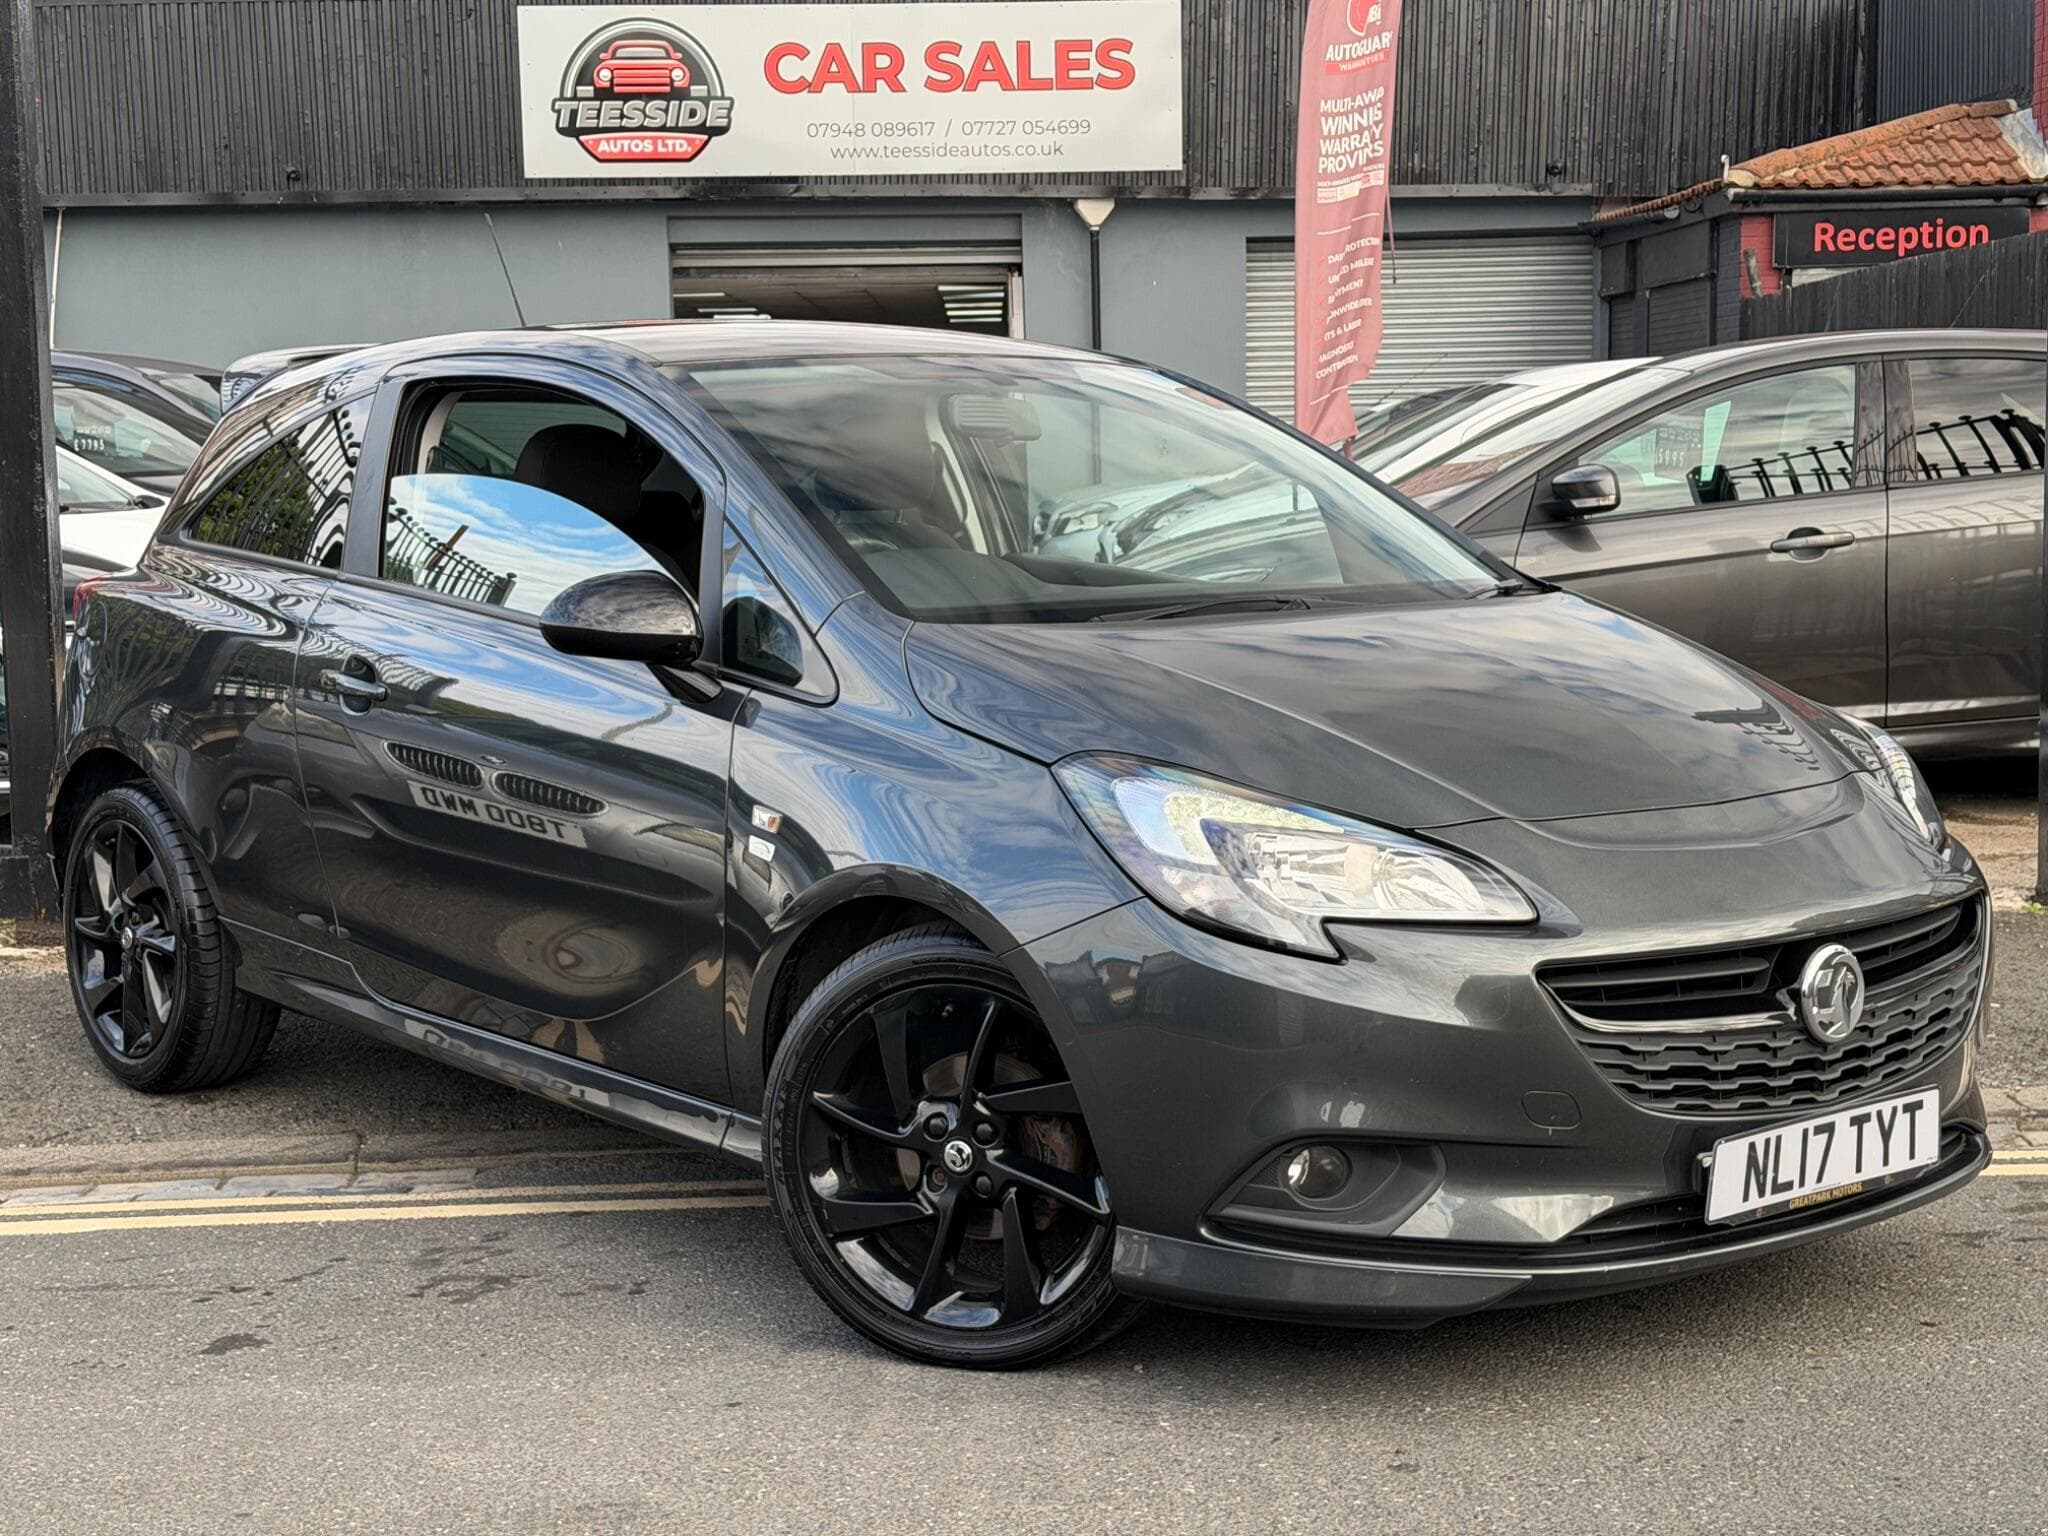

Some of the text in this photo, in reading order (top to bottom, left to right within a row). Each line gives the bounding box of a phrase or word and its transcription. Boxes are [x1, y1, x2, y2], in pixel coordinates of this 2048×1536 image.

[1325, 31, 1393, 61] AUTOGUAR
[764, 38, 1136, 95] CAR SALES
[554, 100, 732, 128] TEESSIDE
[807, 119, 1091, 138] 07948 089617 / 07727 054699
[597, 139, 692, 153] AUTOS LTD.
[830, 140, 1064, 160] www.teessideautos.co.uk
[1813, 218, 1989, 257] Reception
[1742, 1099, 1924, 1203] NL17 TYT
[1831, 1183, 1863, 1199] MOTORS
